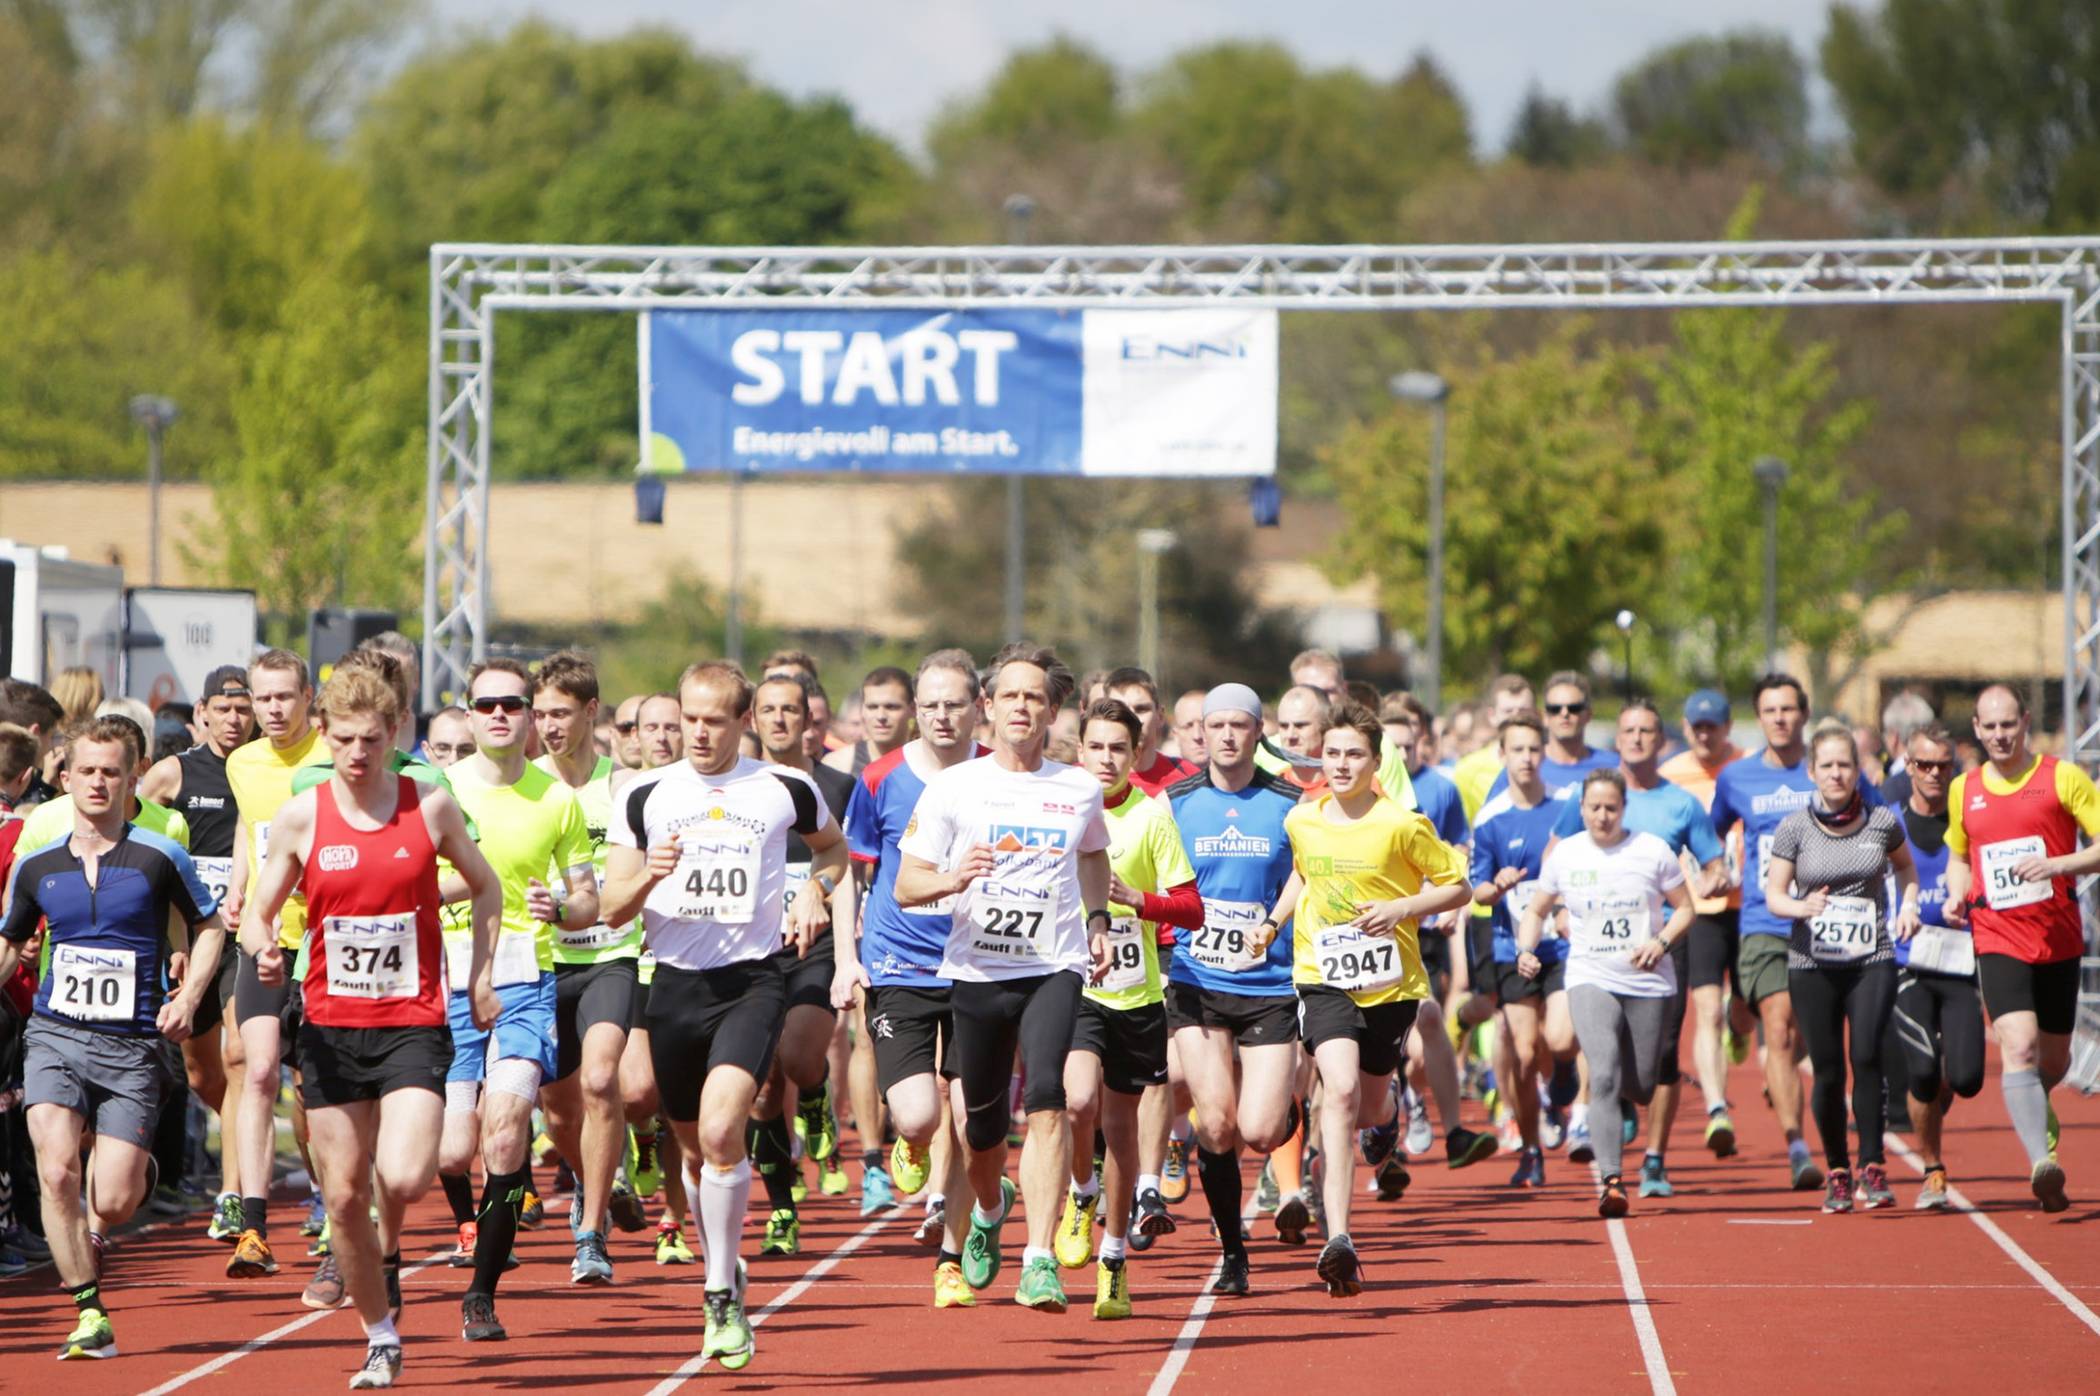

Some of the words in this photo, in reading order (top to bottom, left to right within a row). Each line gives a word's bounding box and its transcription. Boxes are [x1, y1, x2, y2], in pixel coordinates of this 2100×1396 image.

[731, 329, 1019, 406] START
[733, 426, 890, 461] Energievoll
[892, 432, 938, 456] am
[940, 427, 1020, 457] Start.
[1195, 840, 1270, 852] BETHANIEN
[992, 853, 1062, 869] olksbank
[686, 868, 747, 897] 440
[984, 907, 1043, 938] 227
[1602, 918, 1631, 939] 43
[1815, 921, 1872, 944] 2570
[1195, 925, 1244, 953] 279
[341, 945, 402, 974] 374
[1322, 944, 1394, 981] 2947
[65, 975, 119, 1006] 210
